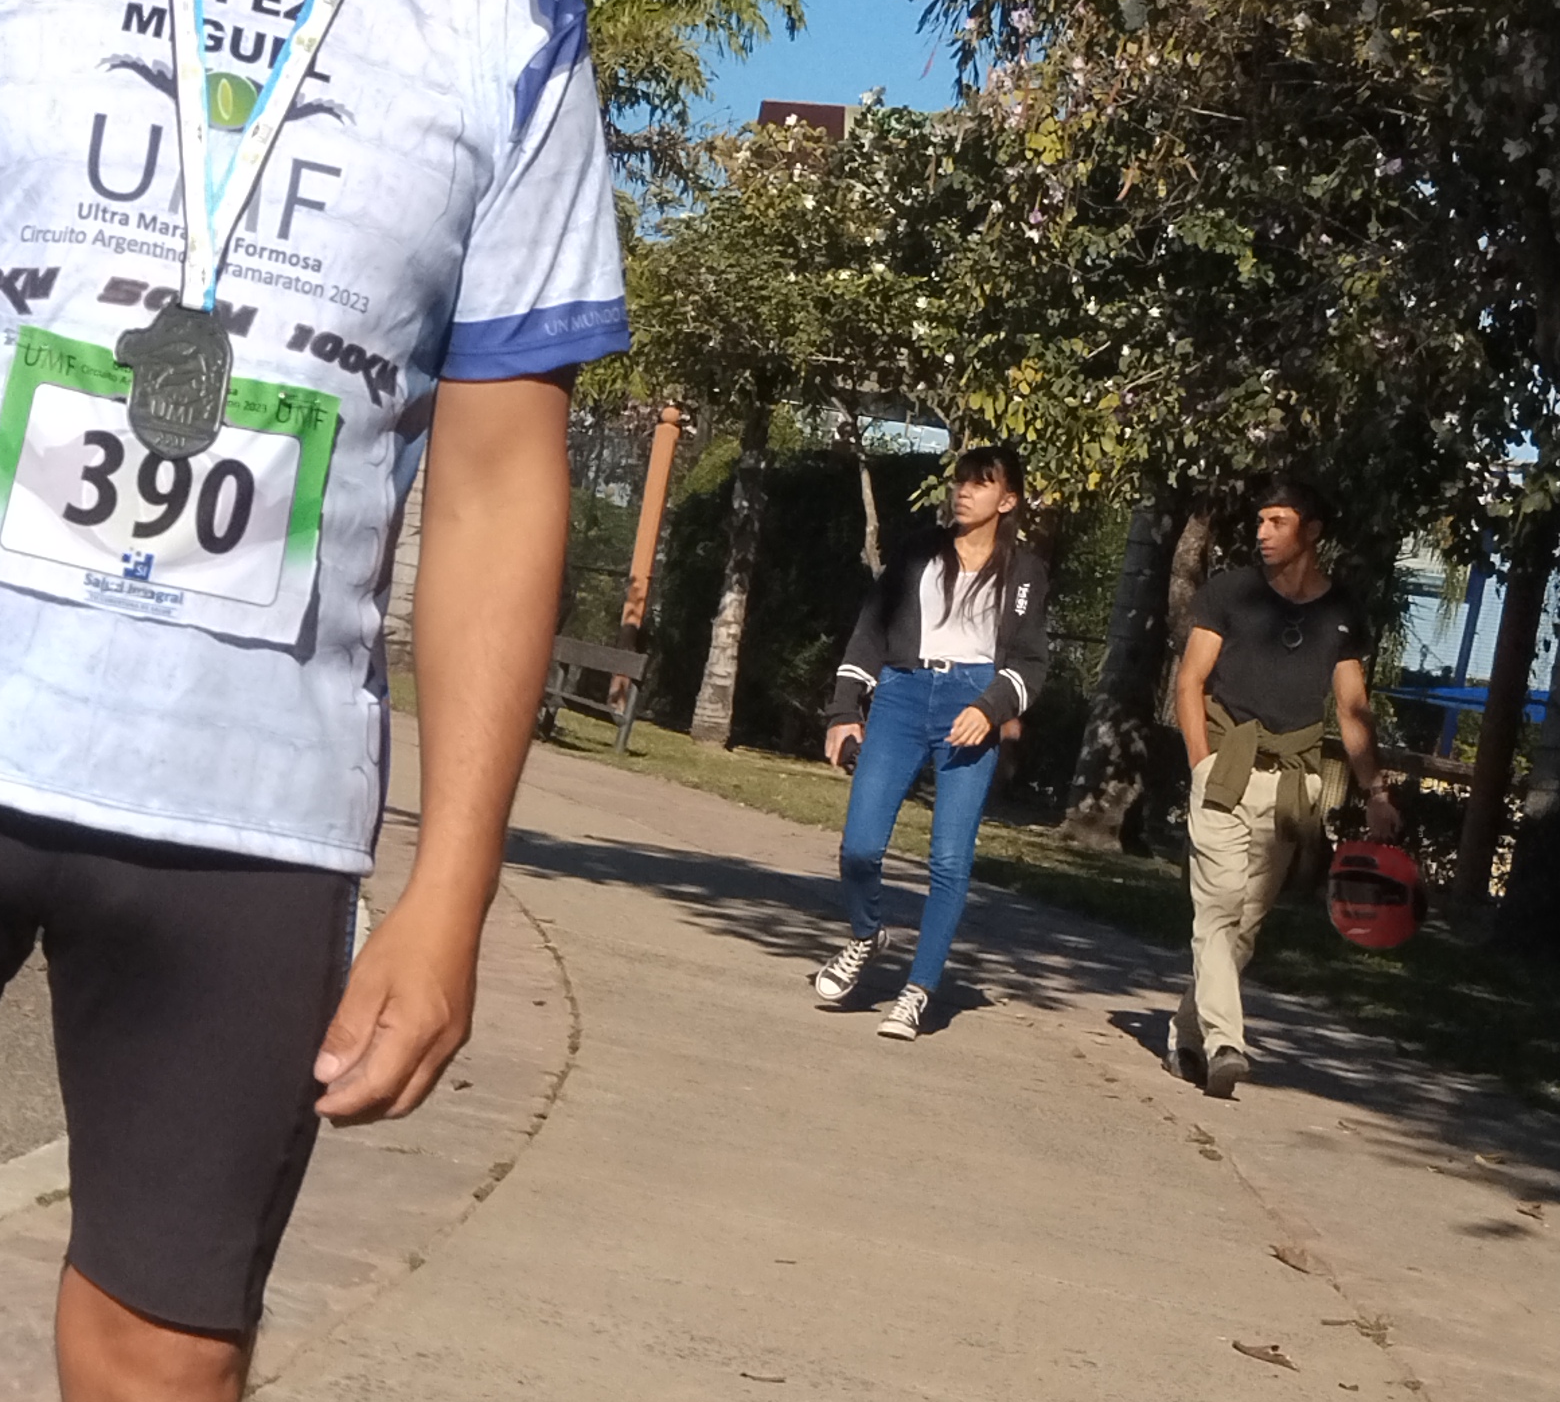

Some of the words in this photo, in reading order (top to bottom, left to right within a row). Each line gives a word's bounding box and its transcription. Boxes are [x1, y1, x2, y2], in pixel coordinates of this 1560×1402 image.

[122, 2, 331, 84] MGUL
[87, 113, 343, 241] UF
[20, 224, 87, 245] Circuito
[224, 261, 325, 299] ramaraton
[329, 284, 370, 315] 2023
[77, 201, 131, 227] Ultra
[136, 212, 188, 241] Mara
[233, 237, 323, 273] Formosa
[96, 276, 259, 338] 50M
[24, 342, 77, 376] UMF
[286, 322, 399, 409] 100KM
[62, 429, 255, 555] 390
